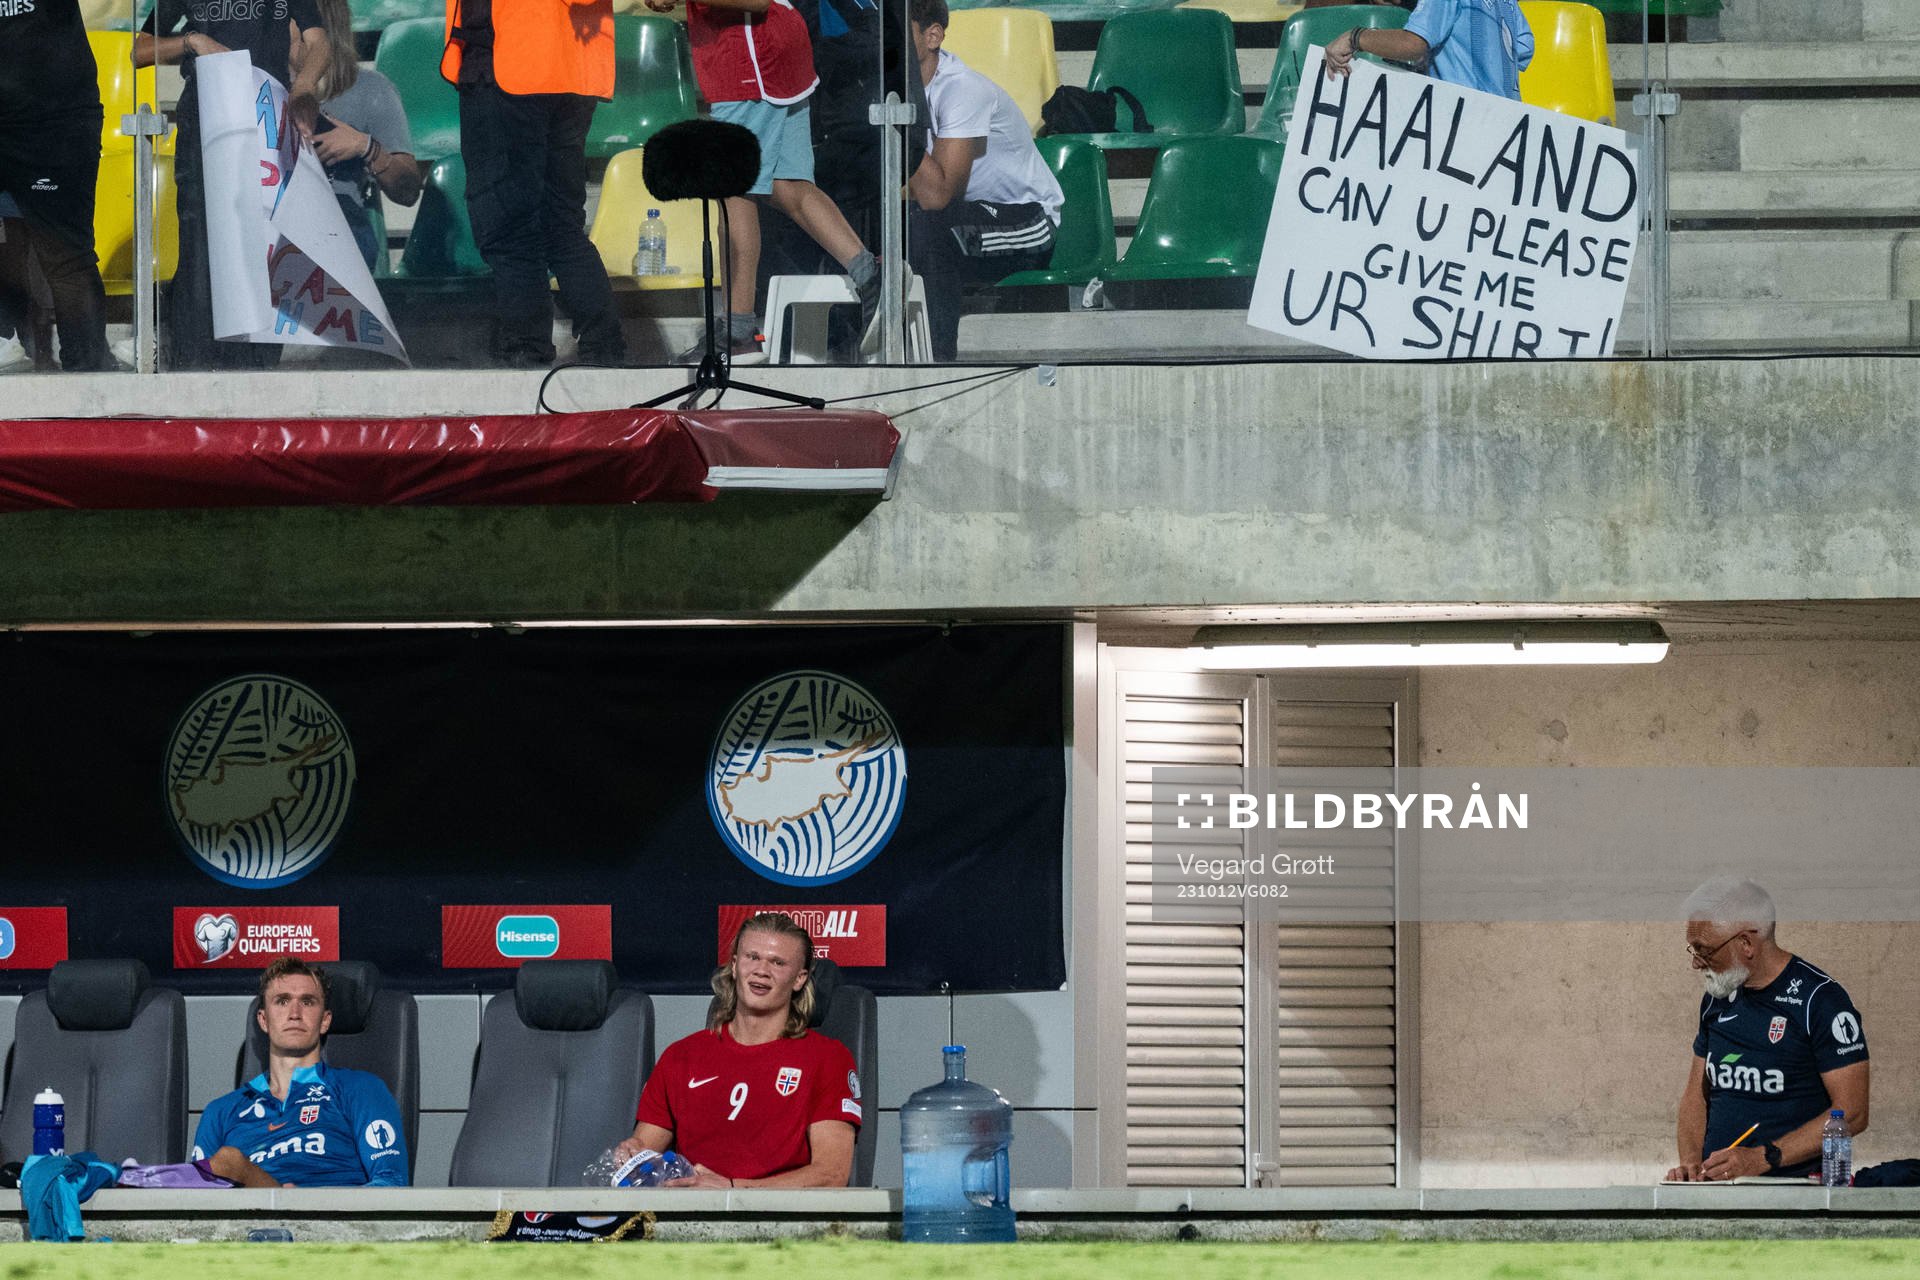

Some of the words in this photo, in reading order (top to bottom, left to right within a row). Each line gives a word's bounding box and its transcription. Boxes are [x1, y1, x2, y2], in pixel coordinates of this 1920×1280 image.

[1301, 59, 1637, 222] HAALAND
[1299, 166, 1392, 226] CAN
[1416, 196, 1449, 241] U
[1467, 207, 1631, 282] PLEASE
[1364, 244, 1468, 296] GIVE
[1475, 271, 1535, 312] ME
[1283, 268, 1376, 348] UR
[238, 938, 321, 955] QUALIFIERS
[247, 925, 312, 938] EUROPEAN
[500, 931, 555, 943] Hisense
[727, 1081, 749, 1121] 9
